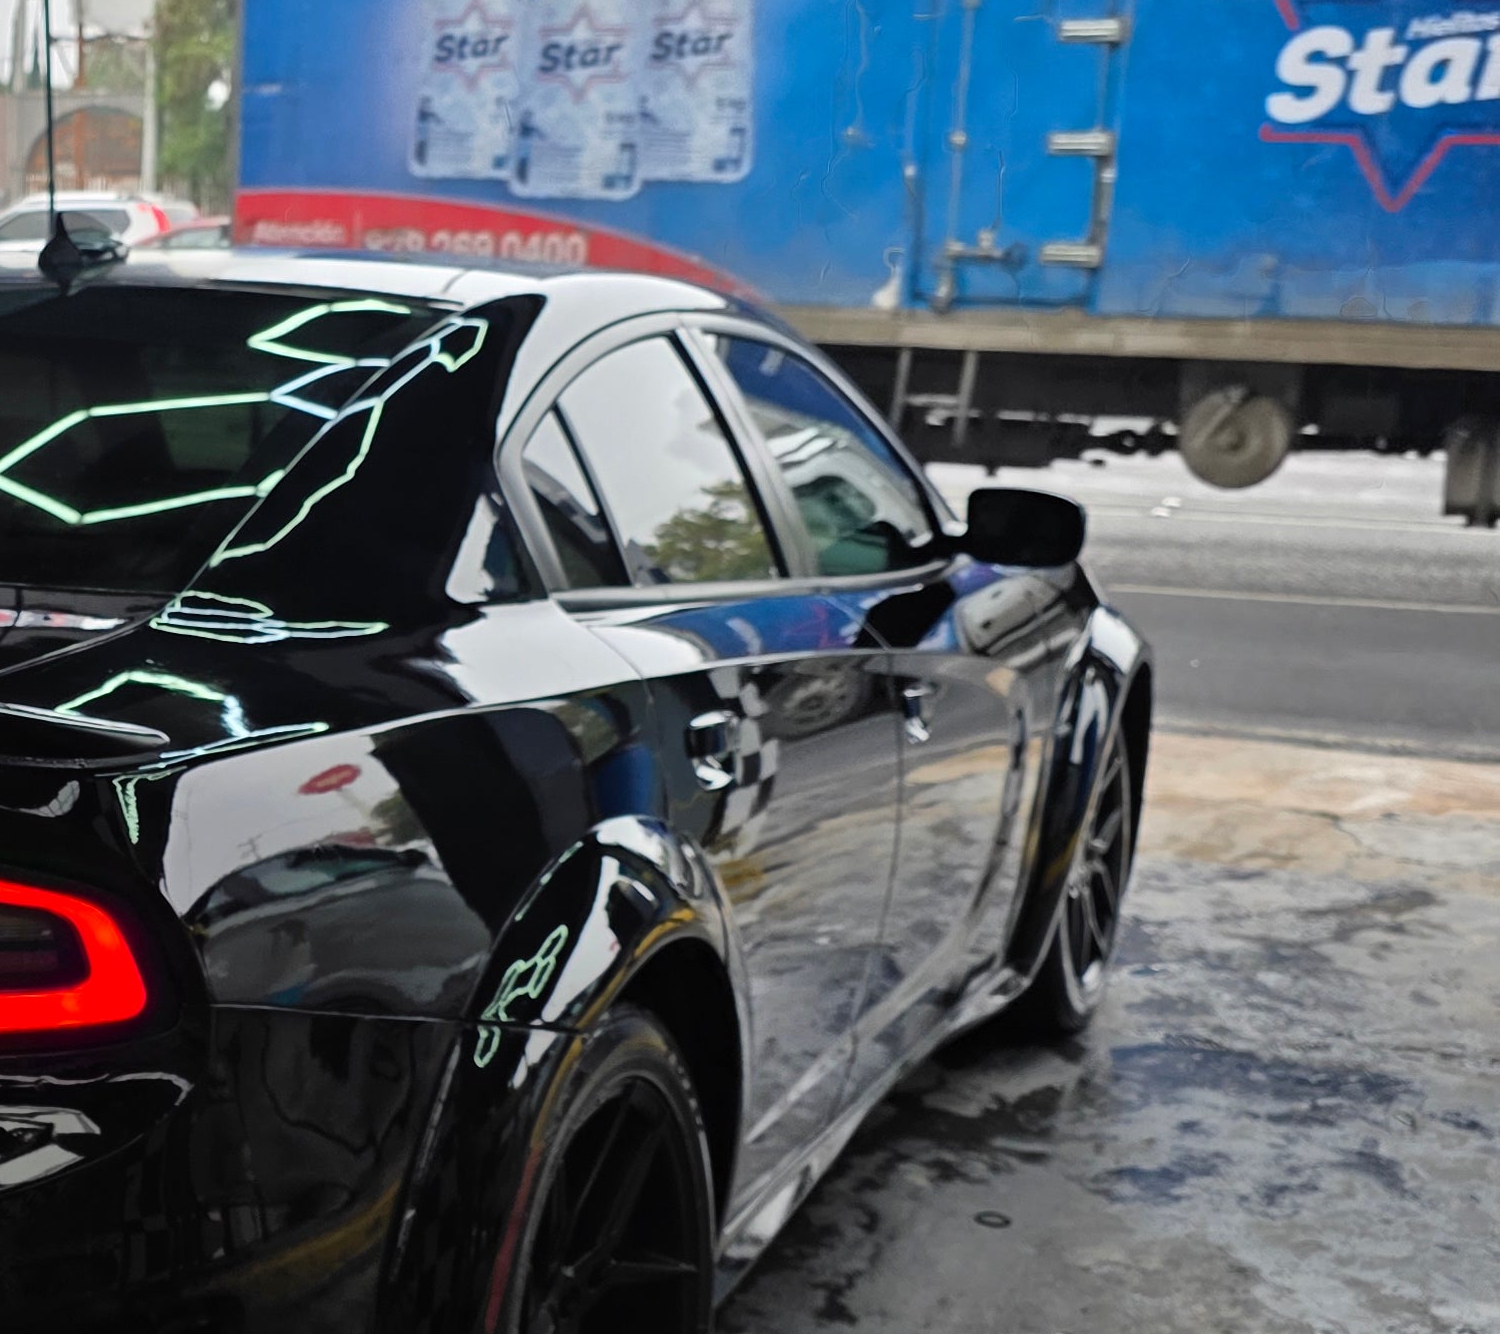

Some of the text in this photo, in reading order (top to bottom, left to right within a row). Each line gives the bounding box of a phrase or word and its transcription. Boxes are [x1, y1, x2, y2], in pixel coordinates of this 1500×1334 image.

[434, 33, 511, 64] Star
[537, 42, 624, 74] Star
[651, 31, 734, 62] Star
